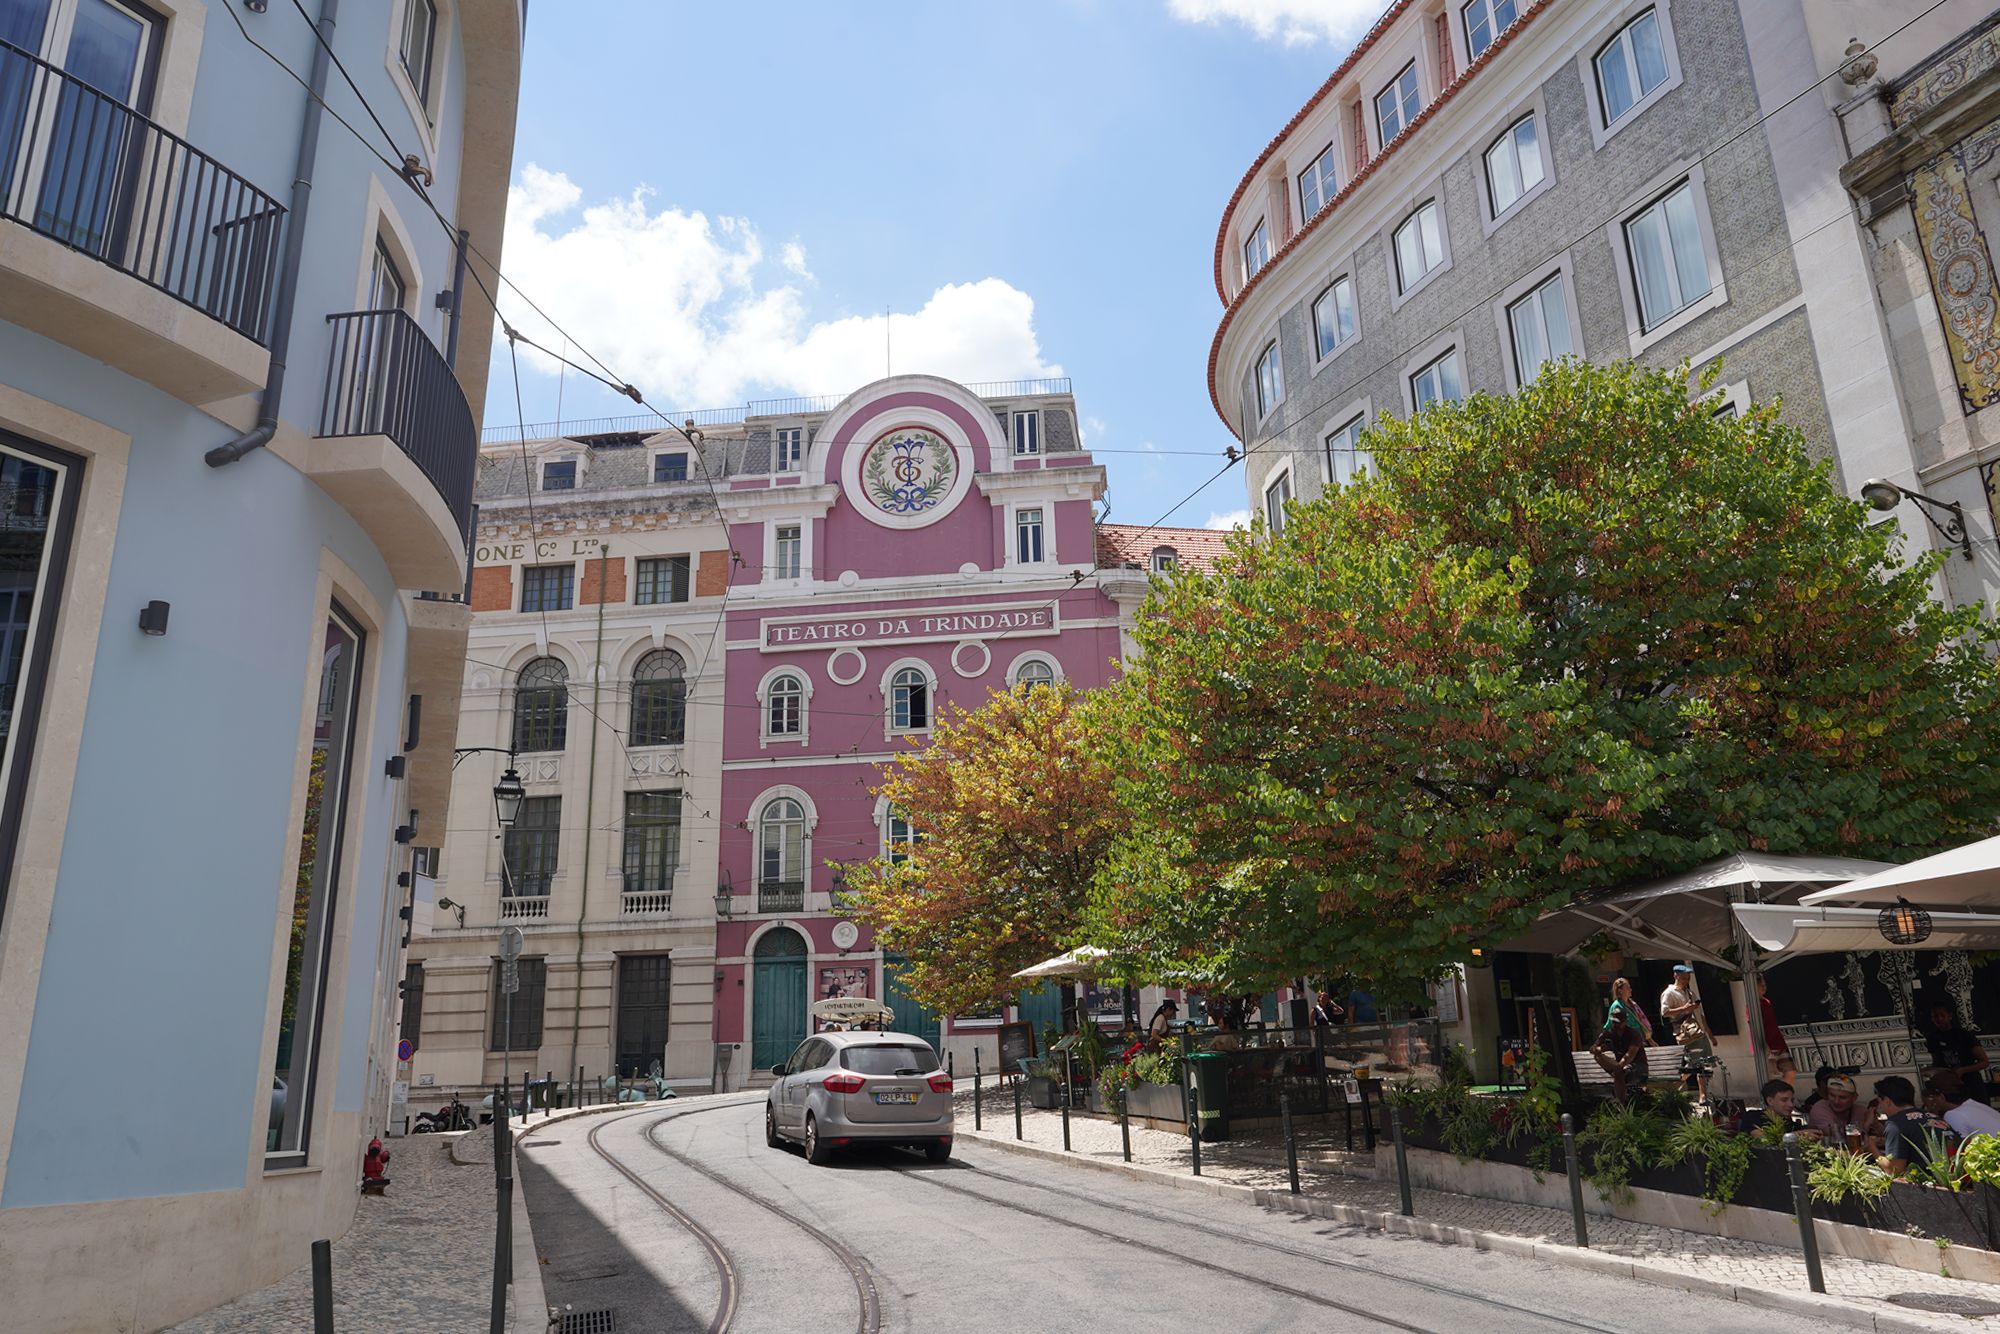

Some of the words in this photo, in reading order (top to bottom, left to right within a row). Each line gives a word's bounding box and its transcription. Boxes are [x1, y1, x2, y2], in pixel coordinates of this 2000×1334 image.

[772, 622, 866, 641] TEATRO
[878, 620, 911, 635] DA
[920, 611, 1046, 632] TRINDADE
